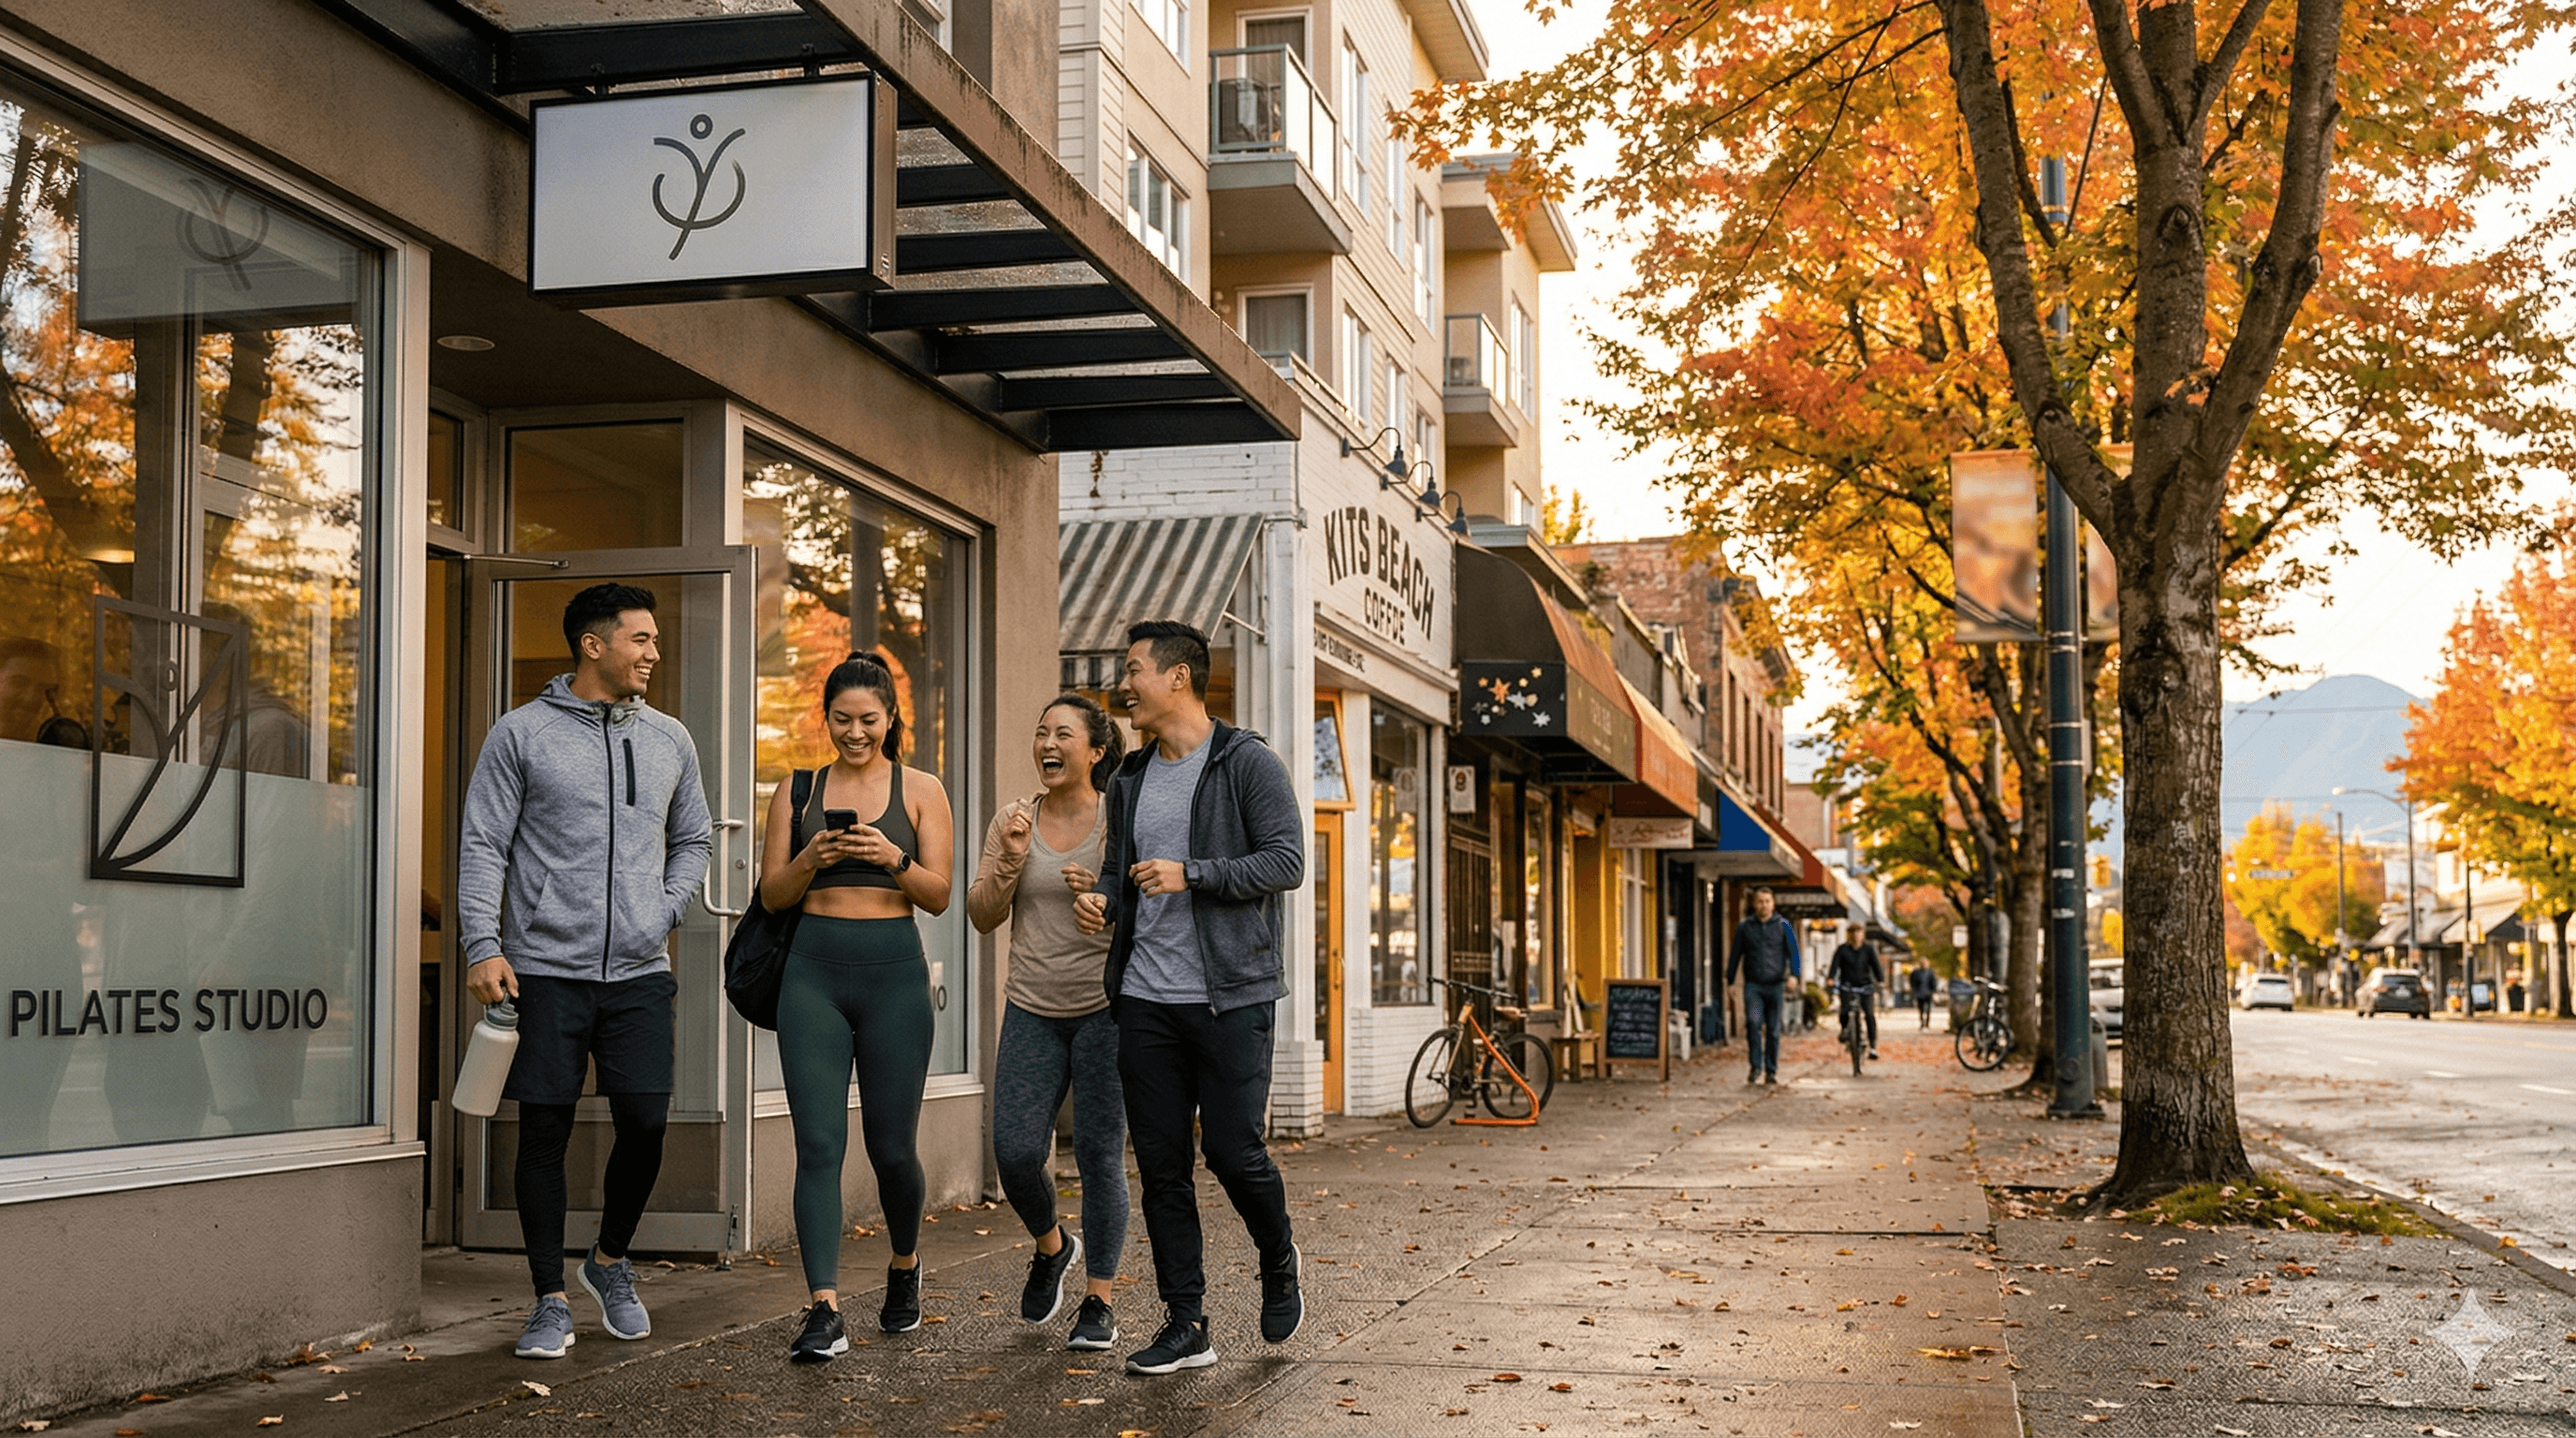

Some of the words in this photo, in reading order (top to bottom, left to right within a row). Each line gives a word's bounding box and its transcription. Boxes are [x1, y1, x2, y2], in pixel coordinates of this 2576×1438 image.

[1323, 506, 1370, 586] KITS
[1378, 515, 1435, 641] BEACH
[11, 989, 181, 1037] PILATES
[195, 988, 329, 1032] STUDIO
